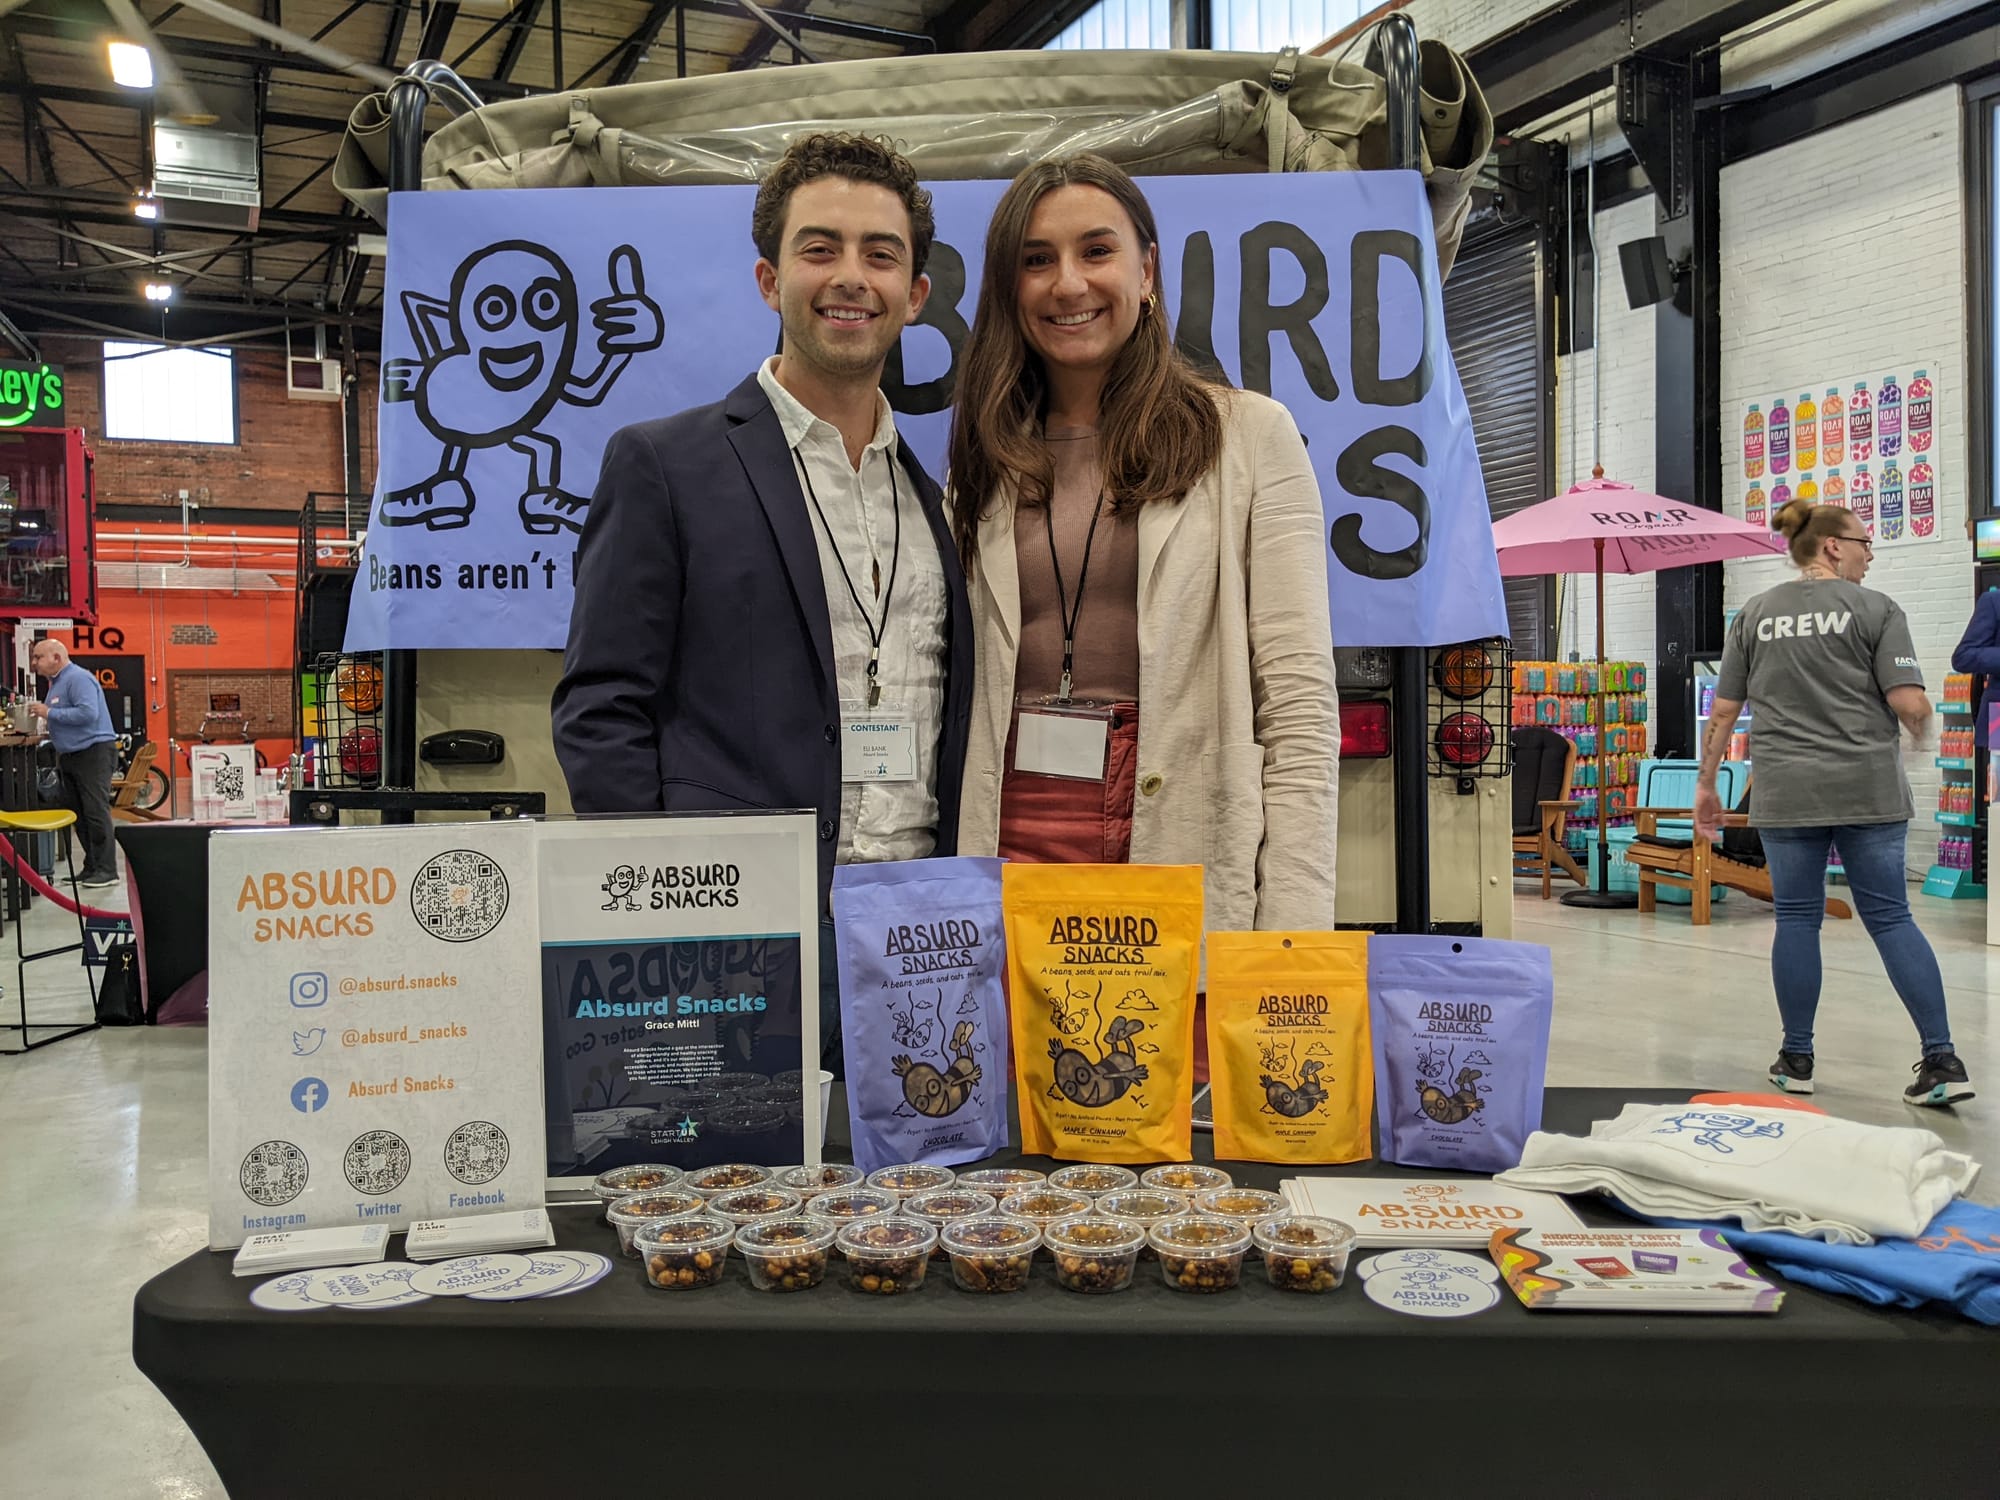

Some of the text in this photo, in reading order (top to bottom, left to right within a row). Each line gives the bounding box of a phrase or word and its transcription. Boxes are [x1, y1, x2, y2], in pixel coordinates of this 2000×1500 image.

[1879, 407, 1900, 421] ROAR
[1909, 402, 1931, 416] ROAR
[1881, 492, 1901, 505] ROAR
[1911, 487, 1932, 501] ROAR
[1591, 509, 1696, 524] ROAR
[369, 553, 442, 592] Beans
[457, 550, 557, 590] aren't
[1757, 611, 1851, 642] CREW
[73, 627, 125, 651] HQ
[850, 724, 899, 732] CONTESTANT
[651, 864, 740, 889] ABSURD
[237, 866, 396, 912] ABSURD
[650, 889, 739, 910] SNACKS
[254, 912, 374, 943] SNACKS
[1050, 916, 1158, 945] ABSURD
[885, 919, 980, 955] ABSURD
[902, 949, 973, 974] SNACKS
[1064, 946, 1145, 963] SNACKS
[1115, 968, 1130, 976] oats
[339, 972, 457, 996] @absurd.snacks
[576, 992, 767, 1019] Absurd Snacks
[1258, 994, 1328, 1014] ABSURD
[1419, 1001, 1492, 1023] ABSURD
[645, 1019, 700, 1031] Grace Mittl
[1267, 1015, 1321, 1026] SNACKS
[1428, 1020, 1483, 1034] SNACKS
[341, 1023, 467, 1048] @absurd_snacks
[348, 1075, 455, 1098] Absurd Snacks
[1063, 1126, 1126, 1136] MAPLE CINNAMON
[449, 1189, 505, 1208] Facebook
[355, 1201, 402, 1218] Twitter
[1358, 1203, 1524, 1220] ABSURD
[242, 1211, 307, 1230] Instagram
[1380, 1220, 1508, 1230] SNACKS
[1541, 1233, 1682, 1241] RIDICULOUSLY TASTY
[436, 1267, 511, 1287] ABSURD
[446, 1275, 502, 1289] SNACKS
[1392, 1290, 1470, 1302] ABSURD
[1402, 1300, 1461, 1308] SNACKS
